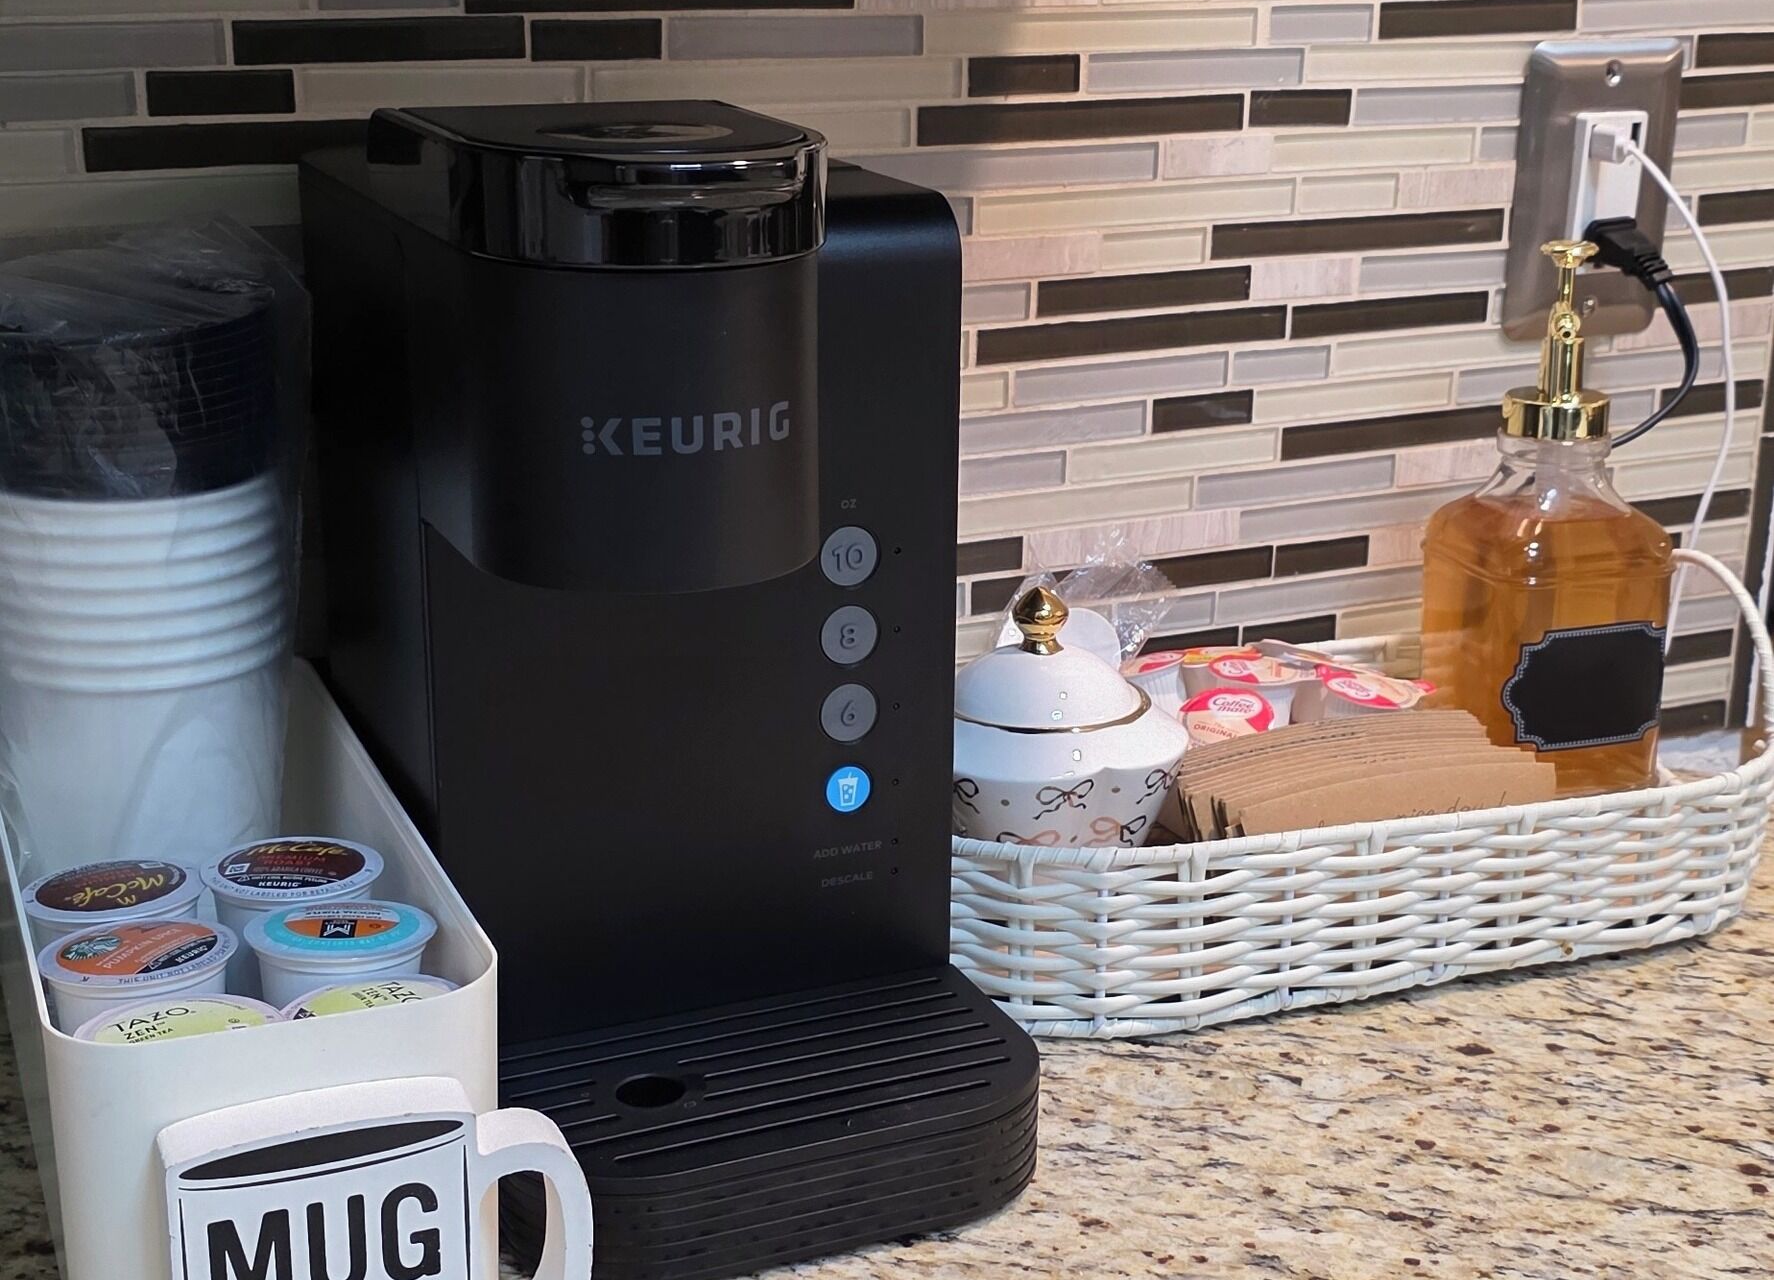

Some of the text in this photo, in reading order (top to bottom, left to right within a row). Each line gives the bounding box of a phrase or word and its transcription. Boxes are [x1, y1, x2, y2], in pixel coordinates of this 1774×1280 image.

[580, 400, 791, 457] KEURIG
[840, 498, 858, 510] OZ
[831, 541, 864, 572] 10
[838, 622, 858, 650] 8
[840, 698, 857, 727] 6
[1212, 696, 1255, 710] Coffee
[813, 839, 883, 859] ADD WATER
[820, 870, 874, 888] DESCALE
[174, 944, 208, 963] KEURIG
[108, 1007, 190, 1033] TAZO
[124, 1024, 158, 1040] ZEN
[156, 1027, 174, 1036] TEA
